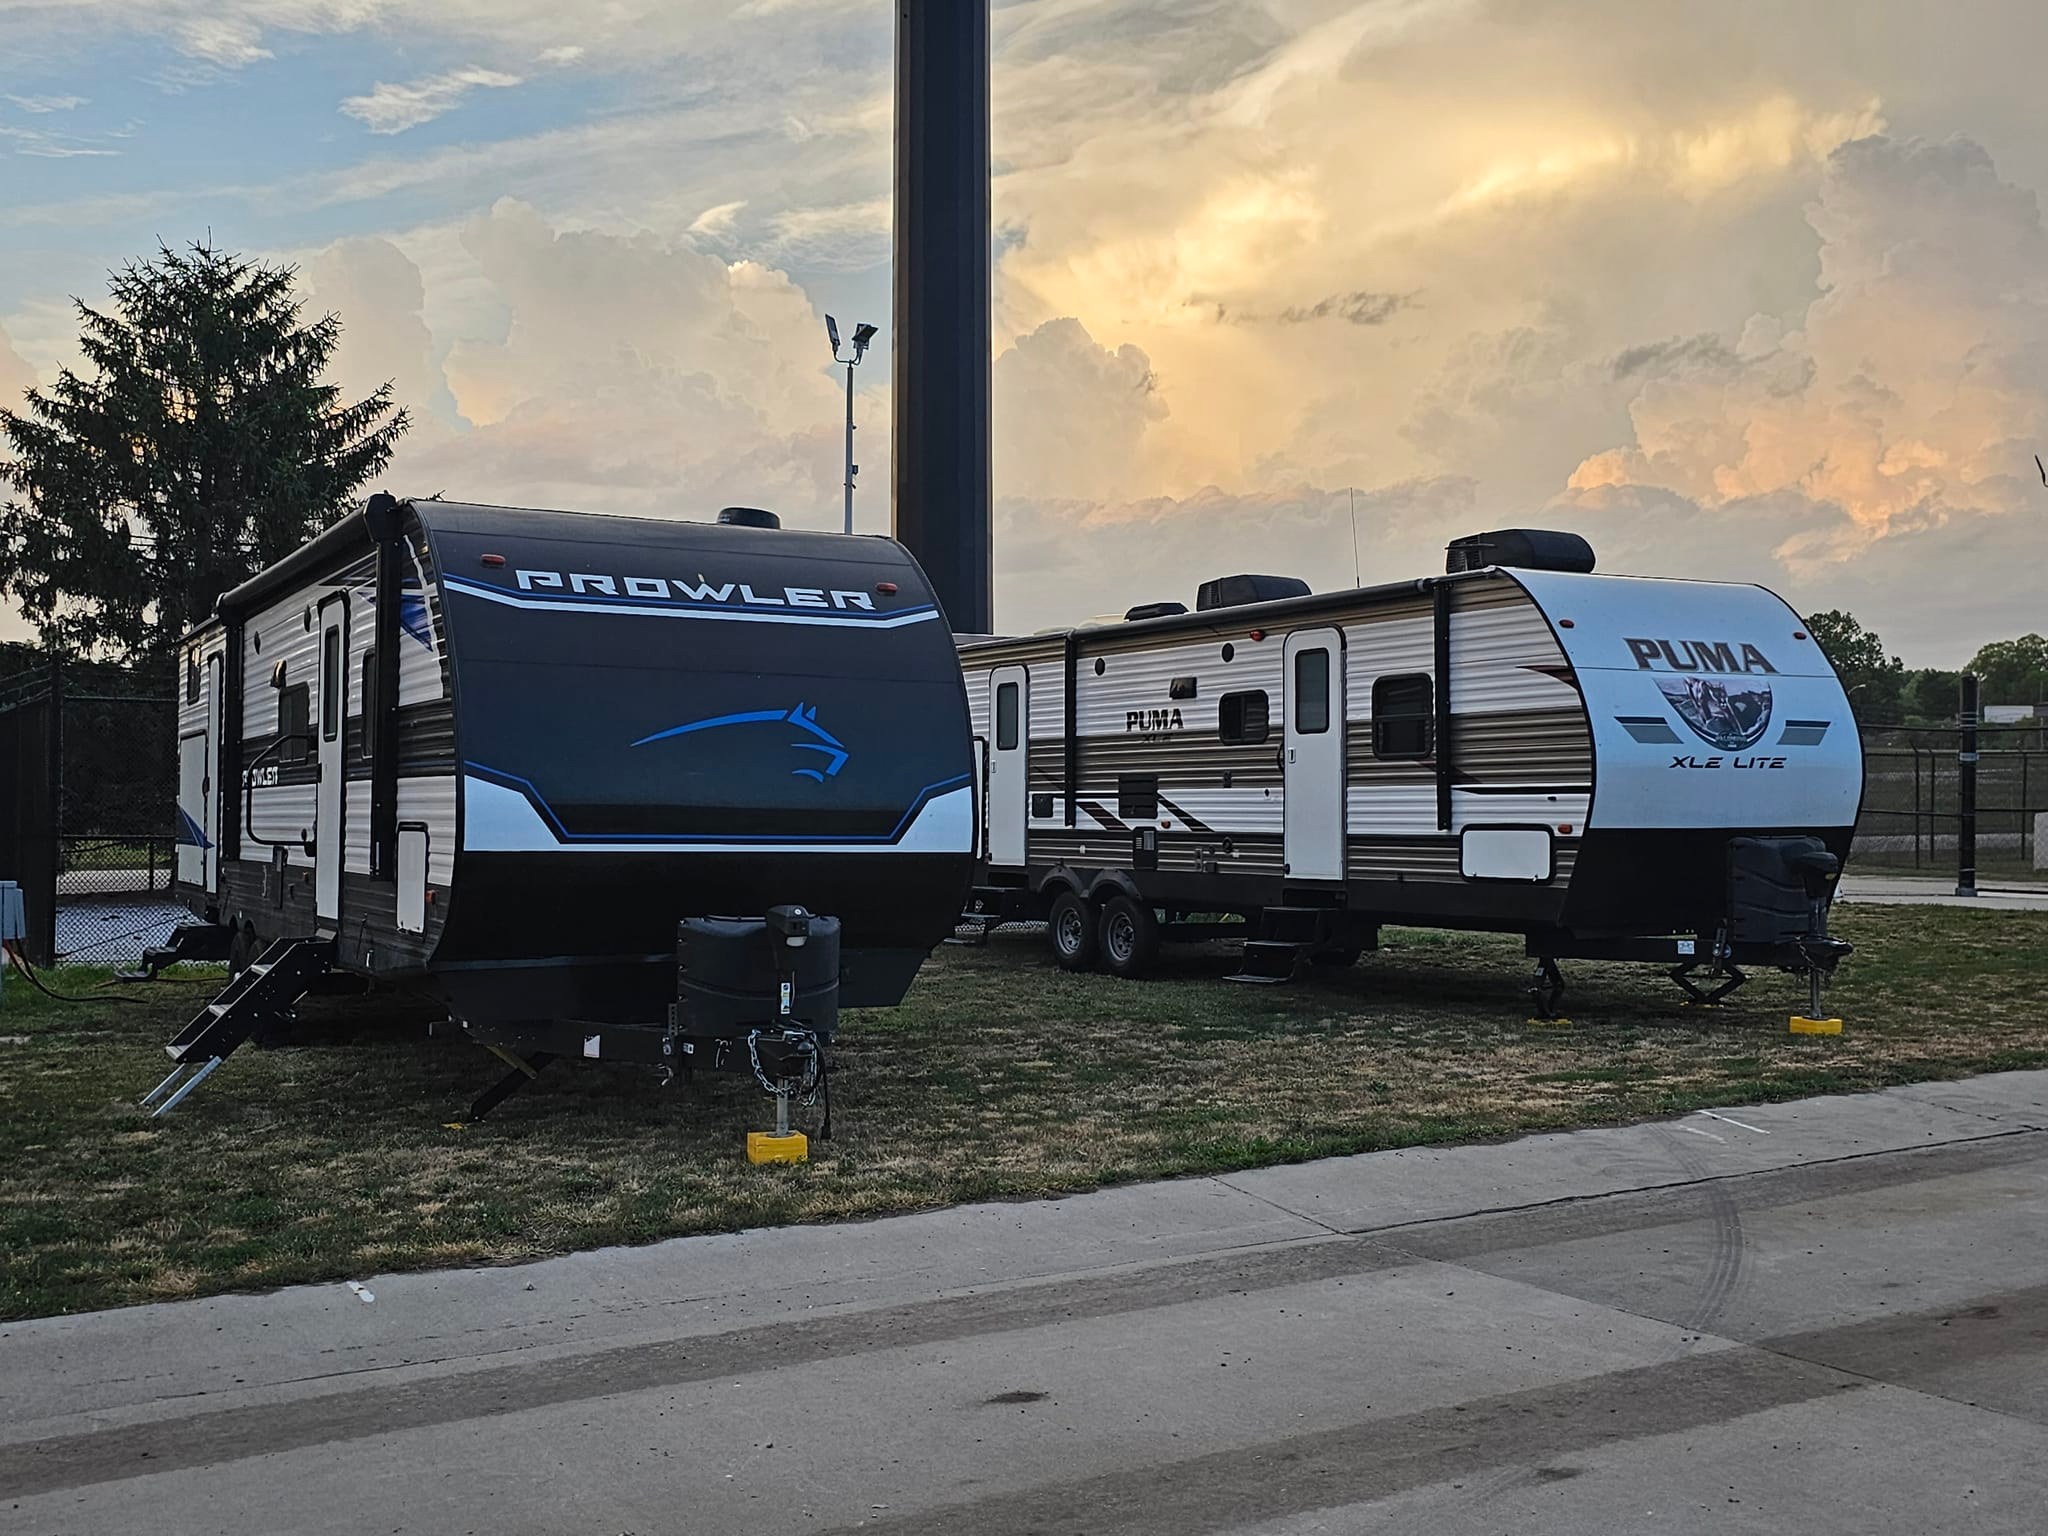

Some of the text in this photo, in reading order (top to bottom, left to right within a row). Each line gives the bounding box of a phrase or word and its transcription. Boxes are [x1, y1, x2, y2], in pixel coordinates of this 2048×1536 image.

[515, 569, 876, 611] PROWLER
[1623, 637, 1779, 674] PUMA
[1126, 708, 1184, 732] PUMA
[1669, 755, 1787, 769] XLE LITE
[241, 766, 279, 787] POWLER
